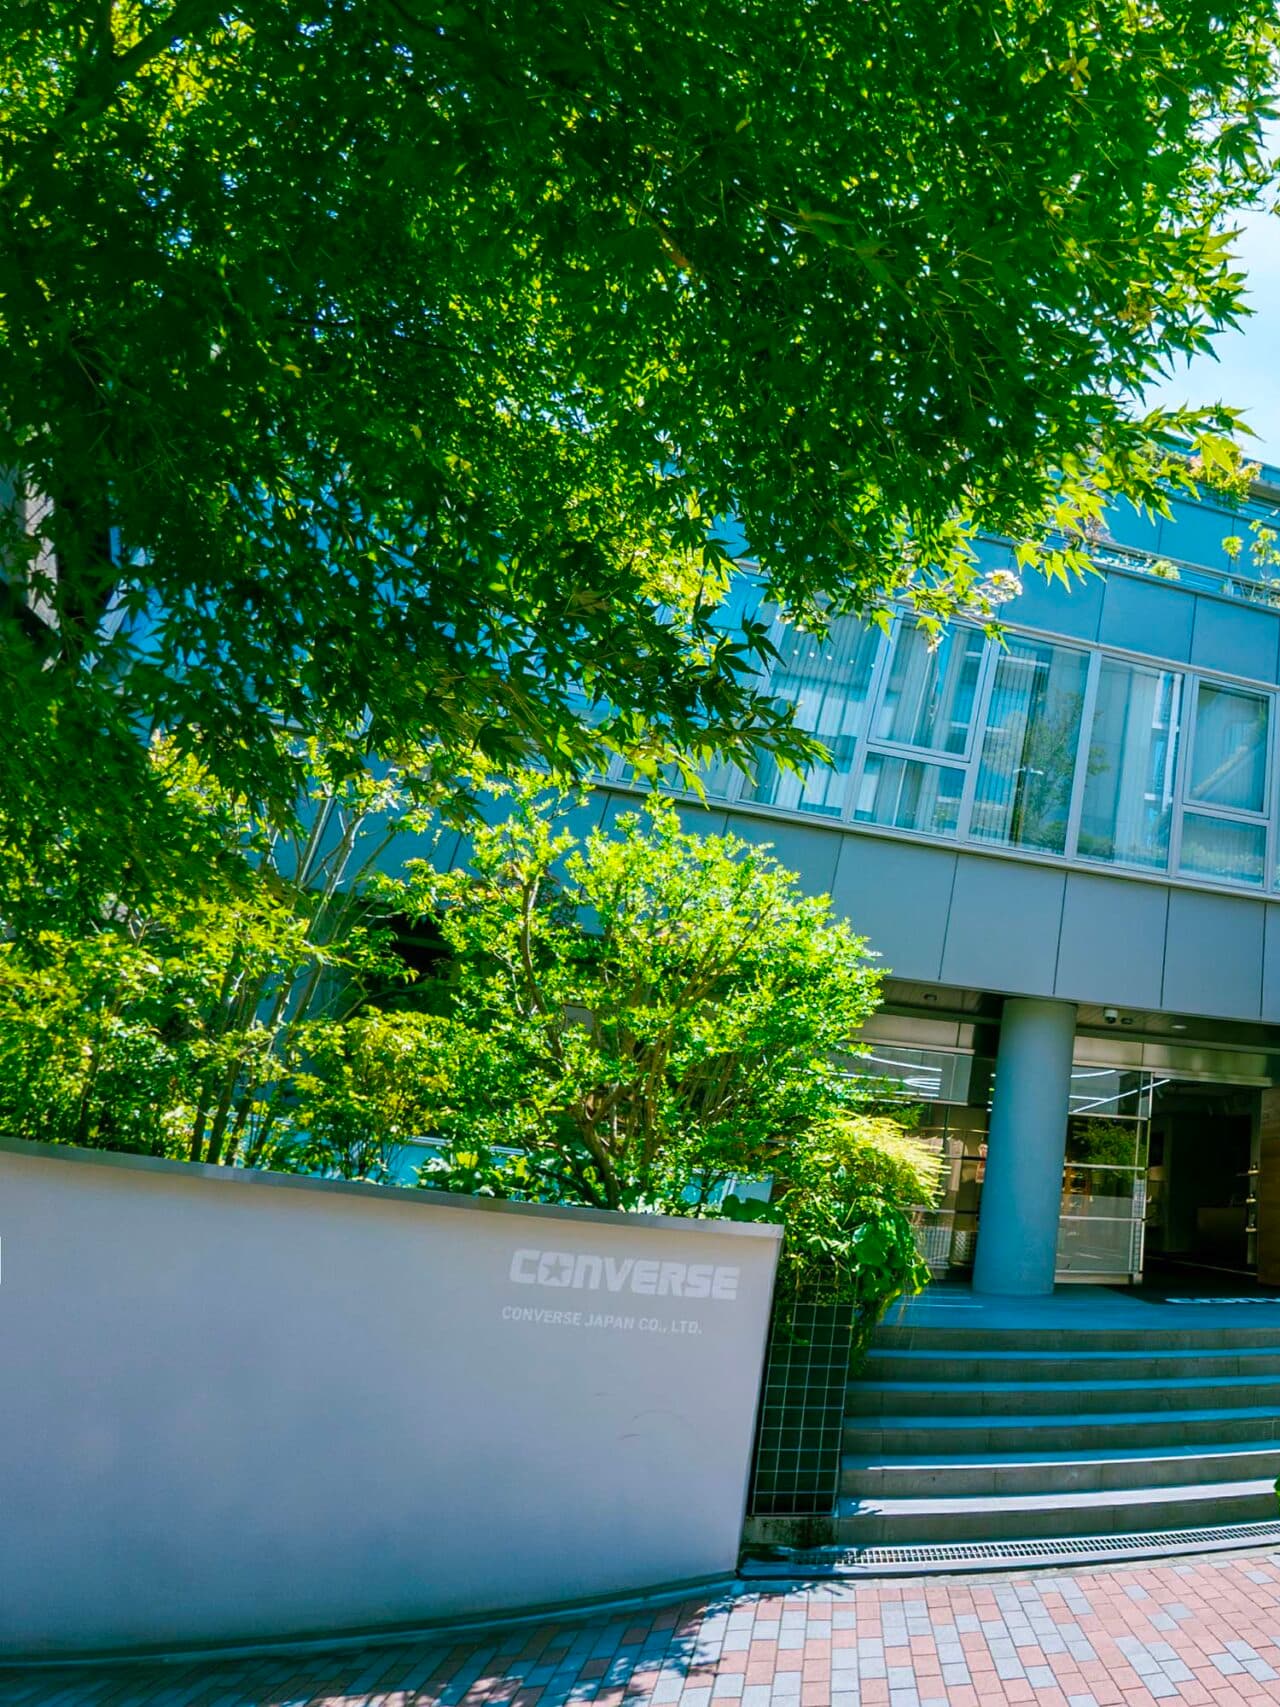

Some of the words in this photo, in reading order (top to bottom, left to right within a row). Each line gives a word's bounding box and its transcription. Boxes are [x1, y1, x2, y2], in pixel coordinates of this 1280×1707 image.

[510, 1249, 740, 1300] CONVERSE
[502, 1305, 581, 1326] CONVERSE
[584, 1313, 634, 1330] JAPAN
[671, 1319, 704, 1335] LTD.
